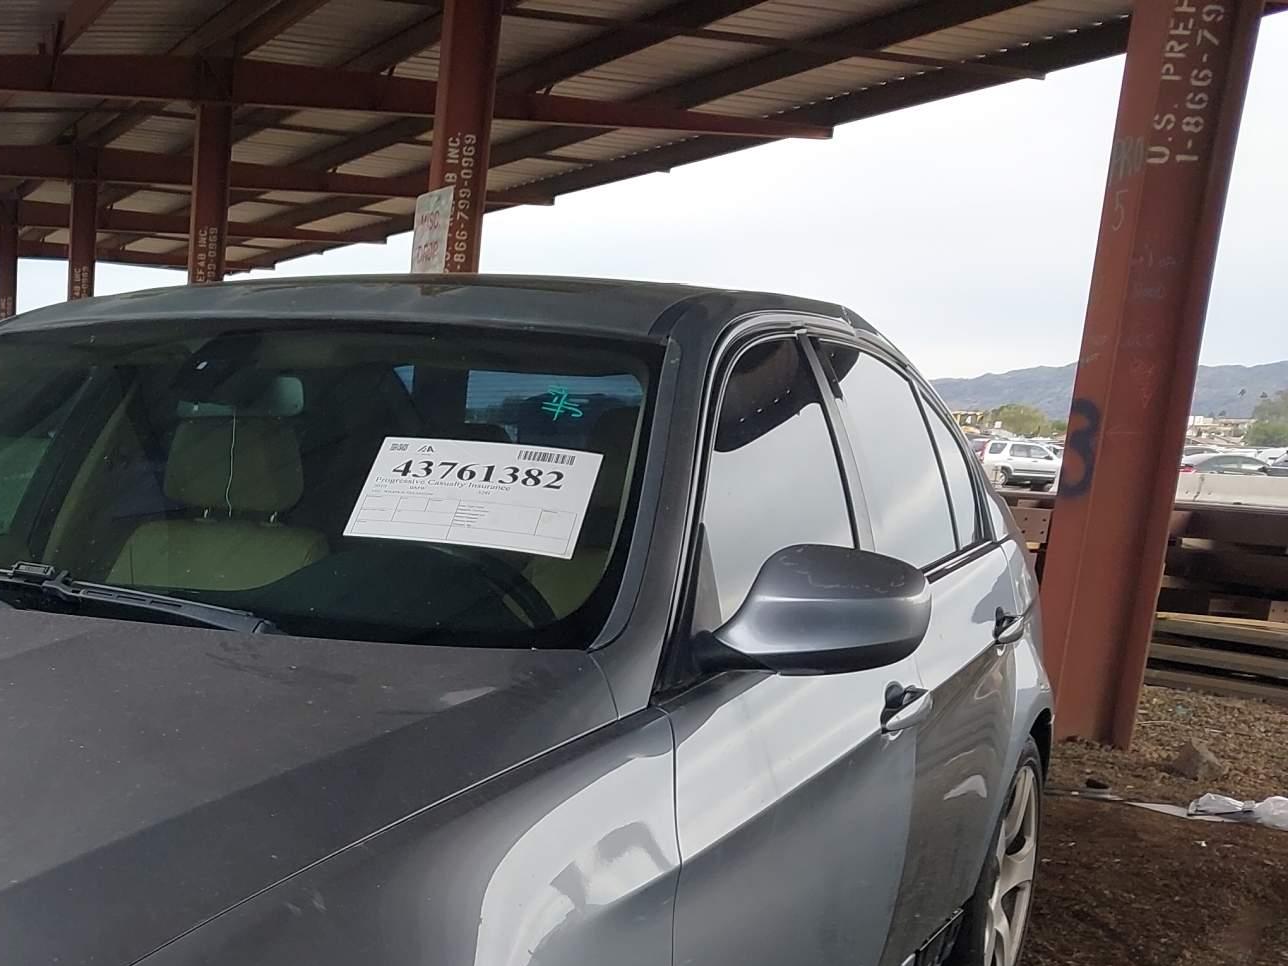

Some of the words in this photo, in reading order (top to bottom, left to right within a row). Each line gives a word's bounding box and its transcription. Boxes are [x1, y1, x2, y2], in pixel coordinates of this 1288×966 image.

[446, 131, 461, 164] INC.
[1146, 103, 1180, 164] U.S.
[375, 476, 426, 486] Progressive
[428, 479, 467, 489] Casualty
[468, 481, 512, 492] Insurance
[392, 458, 565, 490] 43761382
